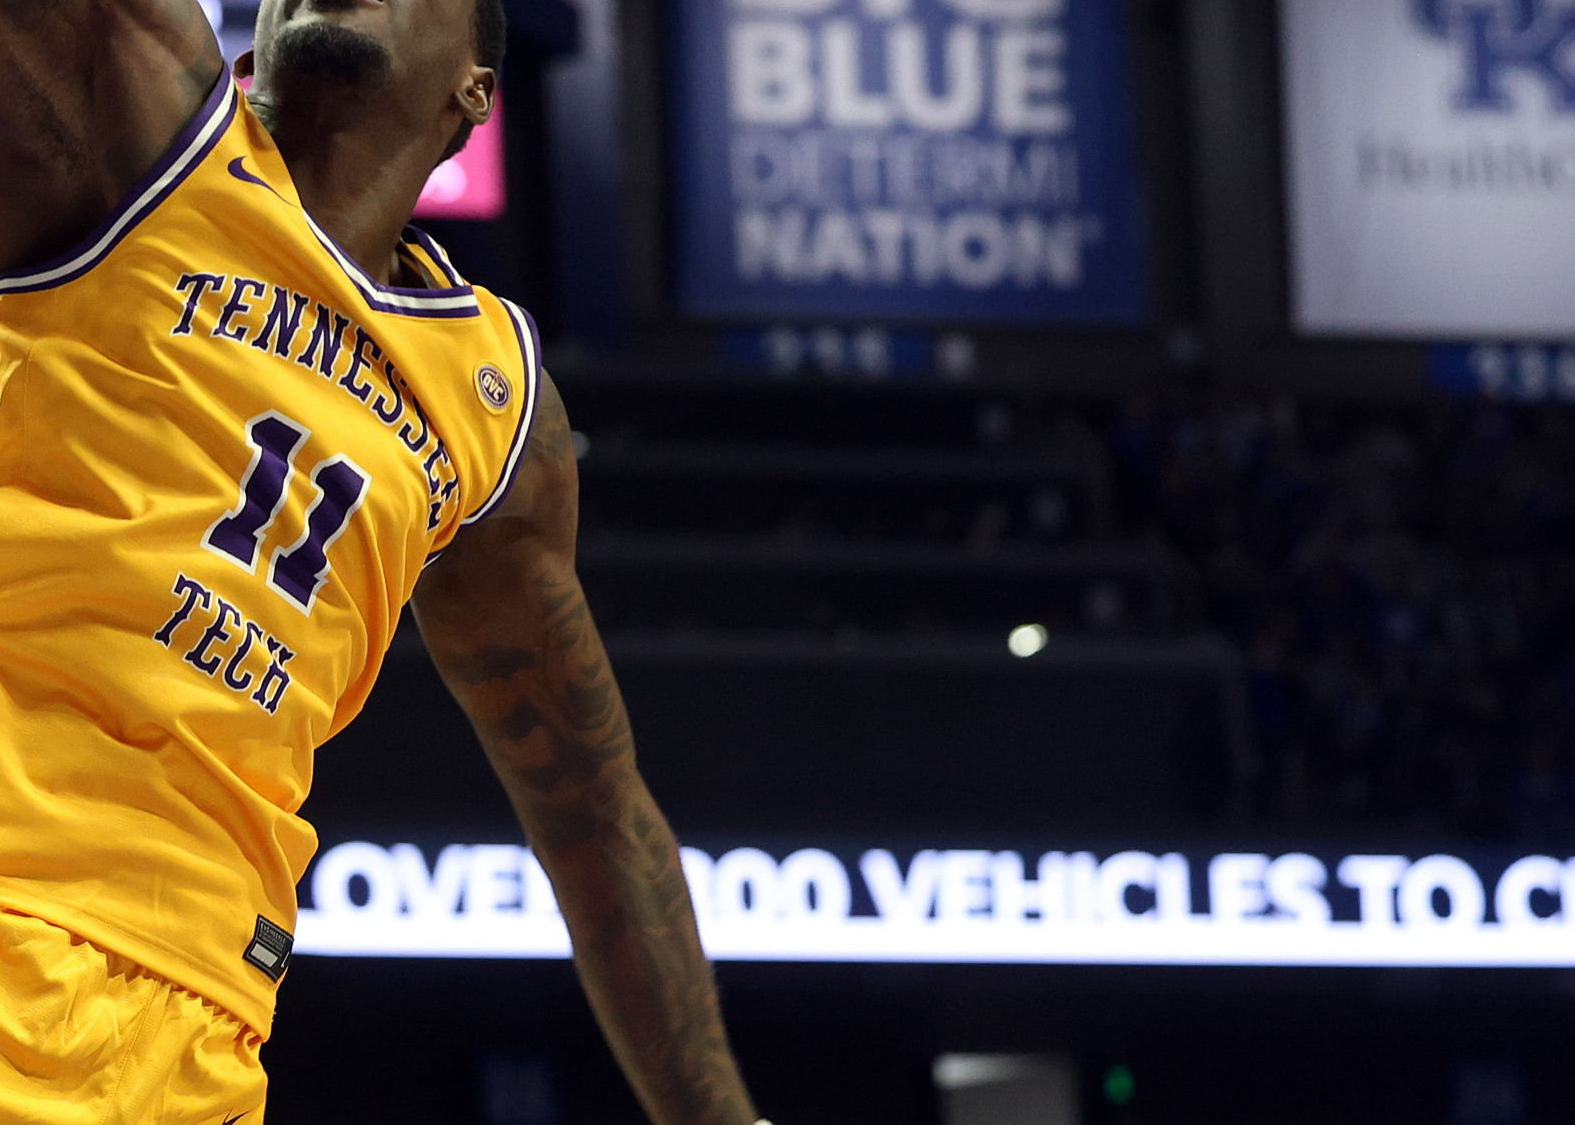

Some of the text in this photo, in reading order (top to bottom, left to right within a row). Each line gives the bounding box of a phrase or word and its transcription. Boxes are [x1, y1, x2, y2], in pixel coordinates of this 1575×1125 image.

[730, 19, 1074, 134] BLUE
[731, 132, 1079, 206] DETERMI
[736, 210, 1085, 286] NATION
[483, 374, 505, 401] OVC
[199, 409, 374, 618] 11
[153, 570, 298, 717] TECH
[859, 848, 1332, 925] VEHICLES
[1336, 853, 1487, 928] TO
